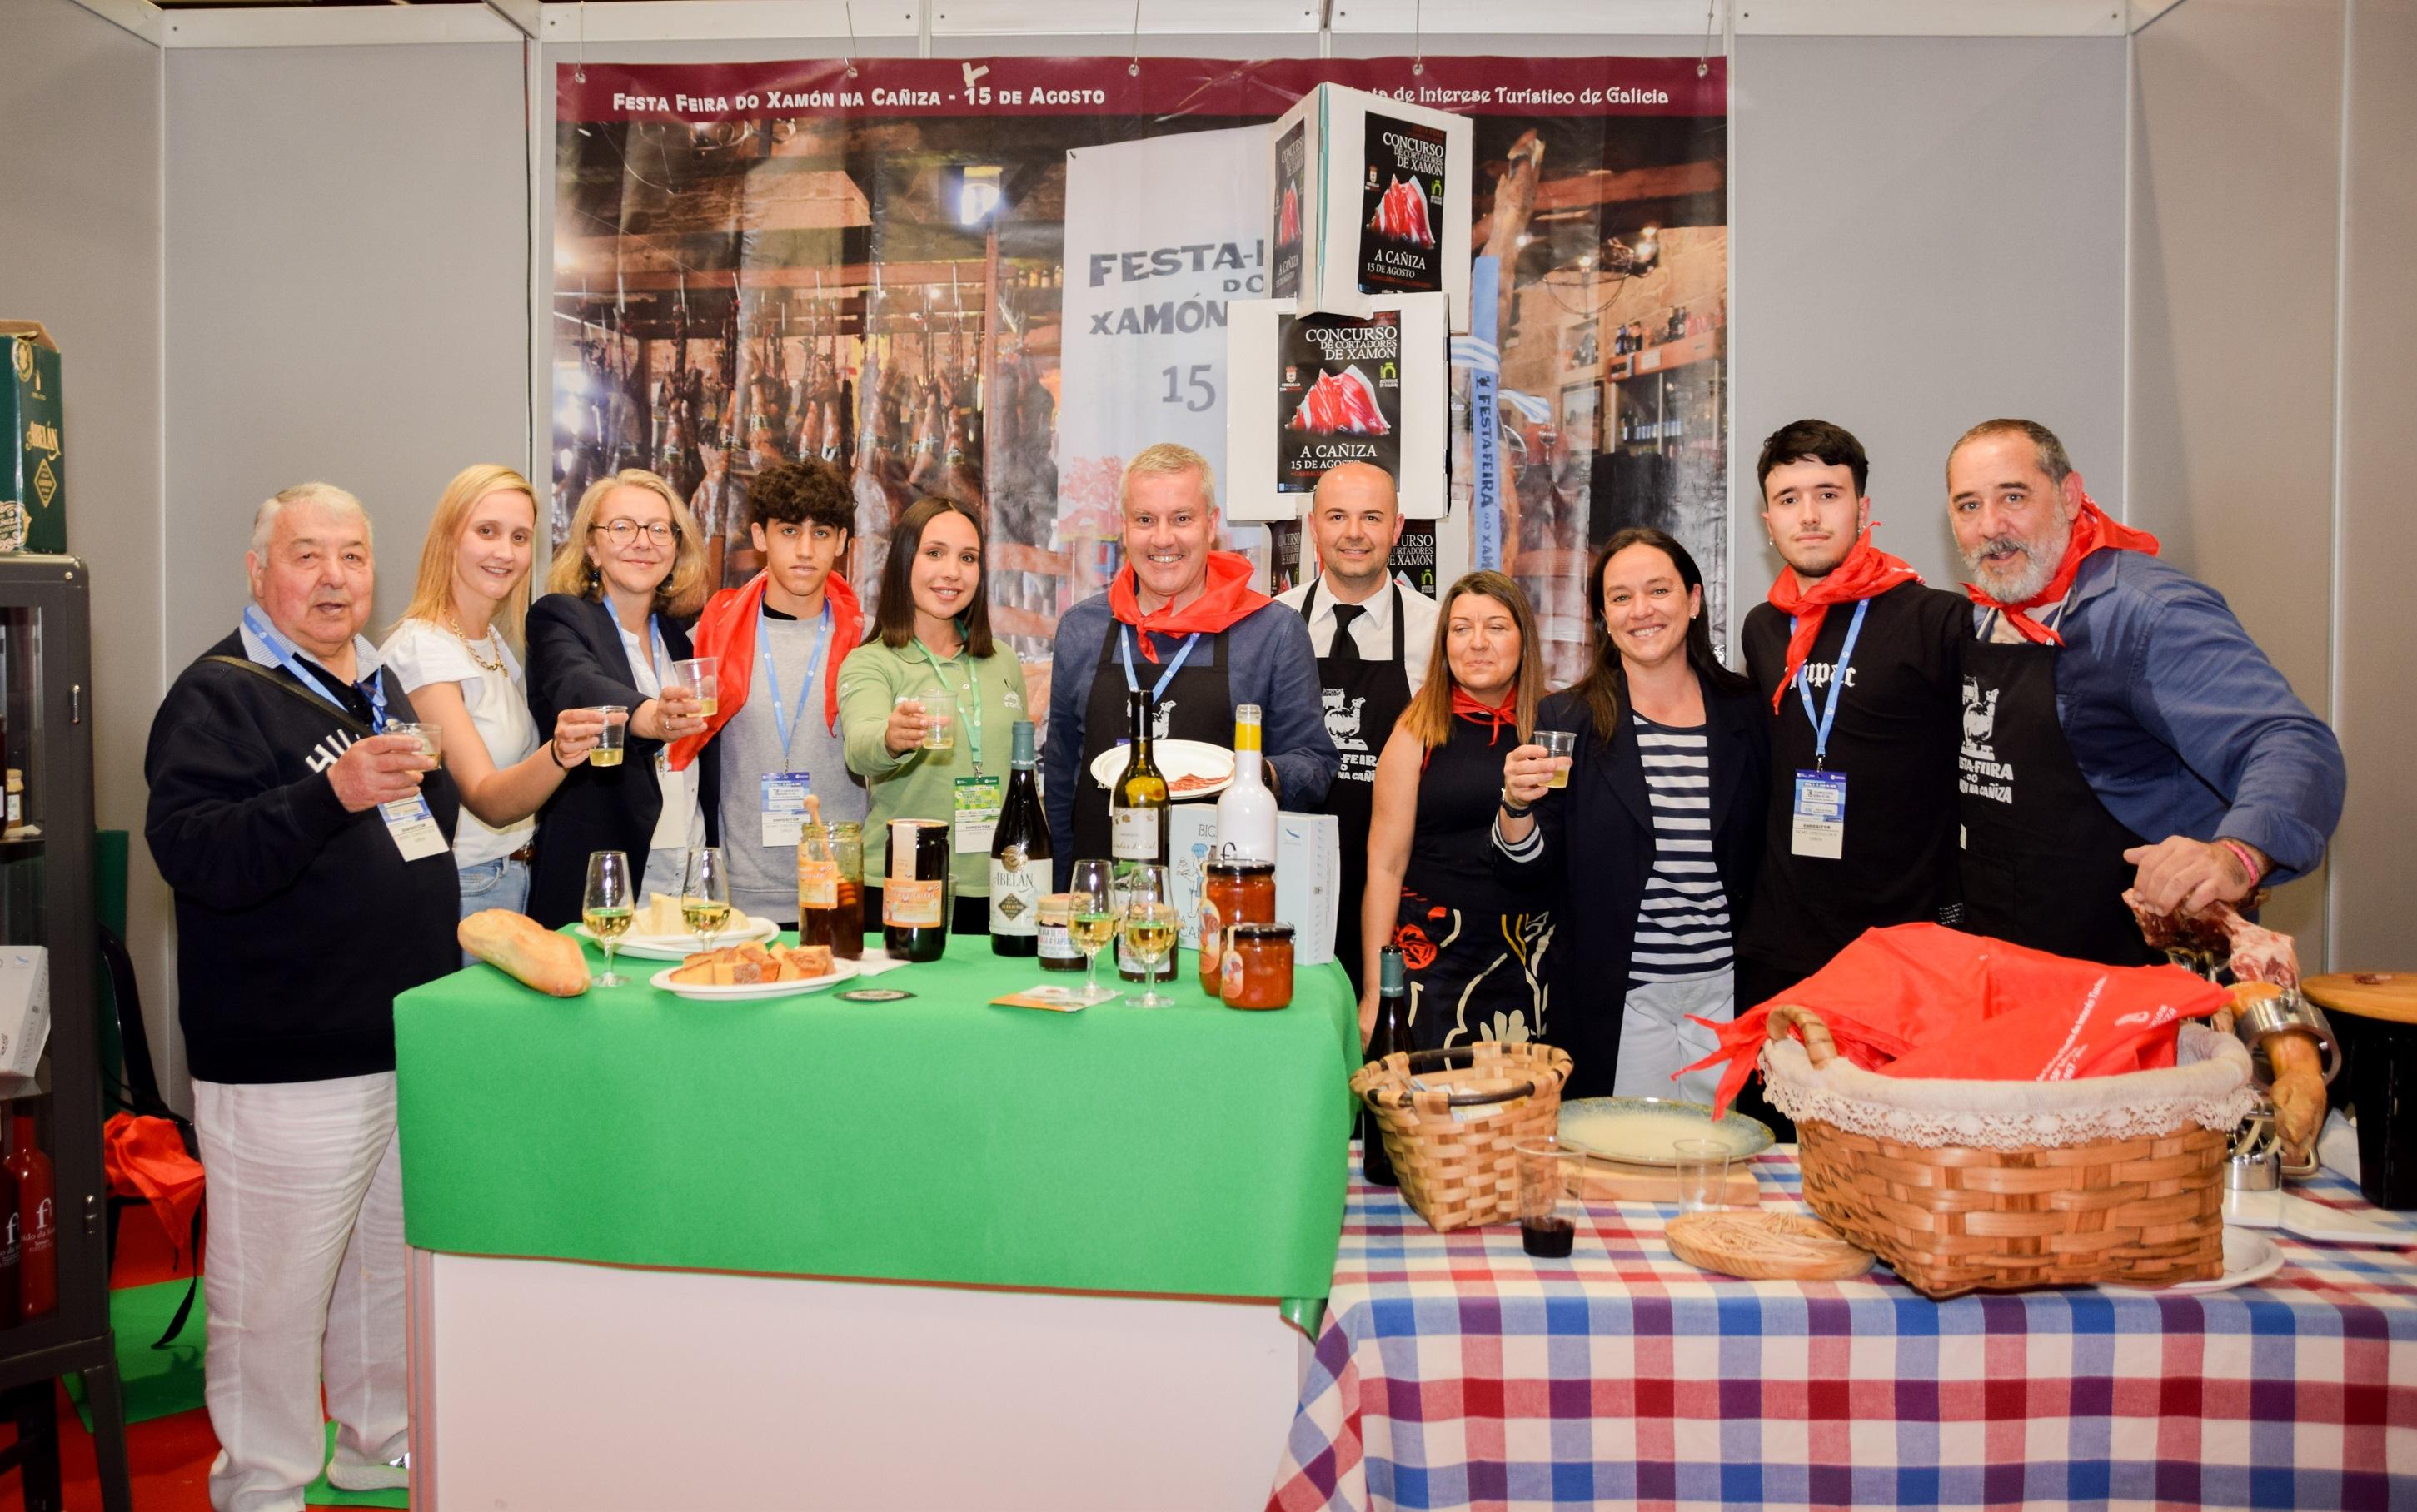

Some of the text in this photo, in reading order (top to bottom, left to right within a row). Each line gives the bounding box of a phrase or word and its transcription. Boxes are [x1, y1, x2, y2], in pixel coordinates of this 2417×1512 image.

[613, 92, 670, 112] FESTA
[675, 94, 728, 112] FEIRA
[735, 95, 759, 110] DO
[767, 89, 834, 109] XAMÓN
[840, 92, 864, 107] NA
[871, 87, 941, 106] CAÑIZA
[964, 87, 991, 105] 15
[999, 91, 1021, 104] DE
[1029, 87, 1105, 105] AGOSTO
[1394, 85, 1415, 102] de
[1420, 87, 1491, 103] Interese
[1494, 87, 1575, 105] Turístico
[1580, 86, 1602, 104] de
[1607, 87, 1669, 104] Galicia
[1383, 132, 1444, 159] CONCURSO
[1397, 156, 1409, 169] DE
[1403, 149, 1443, 167] CORTADORES
[1374, 248, 1426, 270] A CAÑIZA
[1367, 262, 1415, 278] 15 DE AGOSTO
[1089, 292, 1228, 335] XAMÓN
[1305, 326, 1398, 342] CONCURSO
[1320, 340, 1398, 350] DE CORTADORES
[1324, 347, 1396, 361] DE XAMÓN
[1162, 364, 1216, 412] 15
[1300, 443, 1377, 458] A CAÑIZA
[1291, 460, 1302, 470] 15
[1304, 460, 1318, 469] DE
[1401, 535, 1433, 547] URSO
